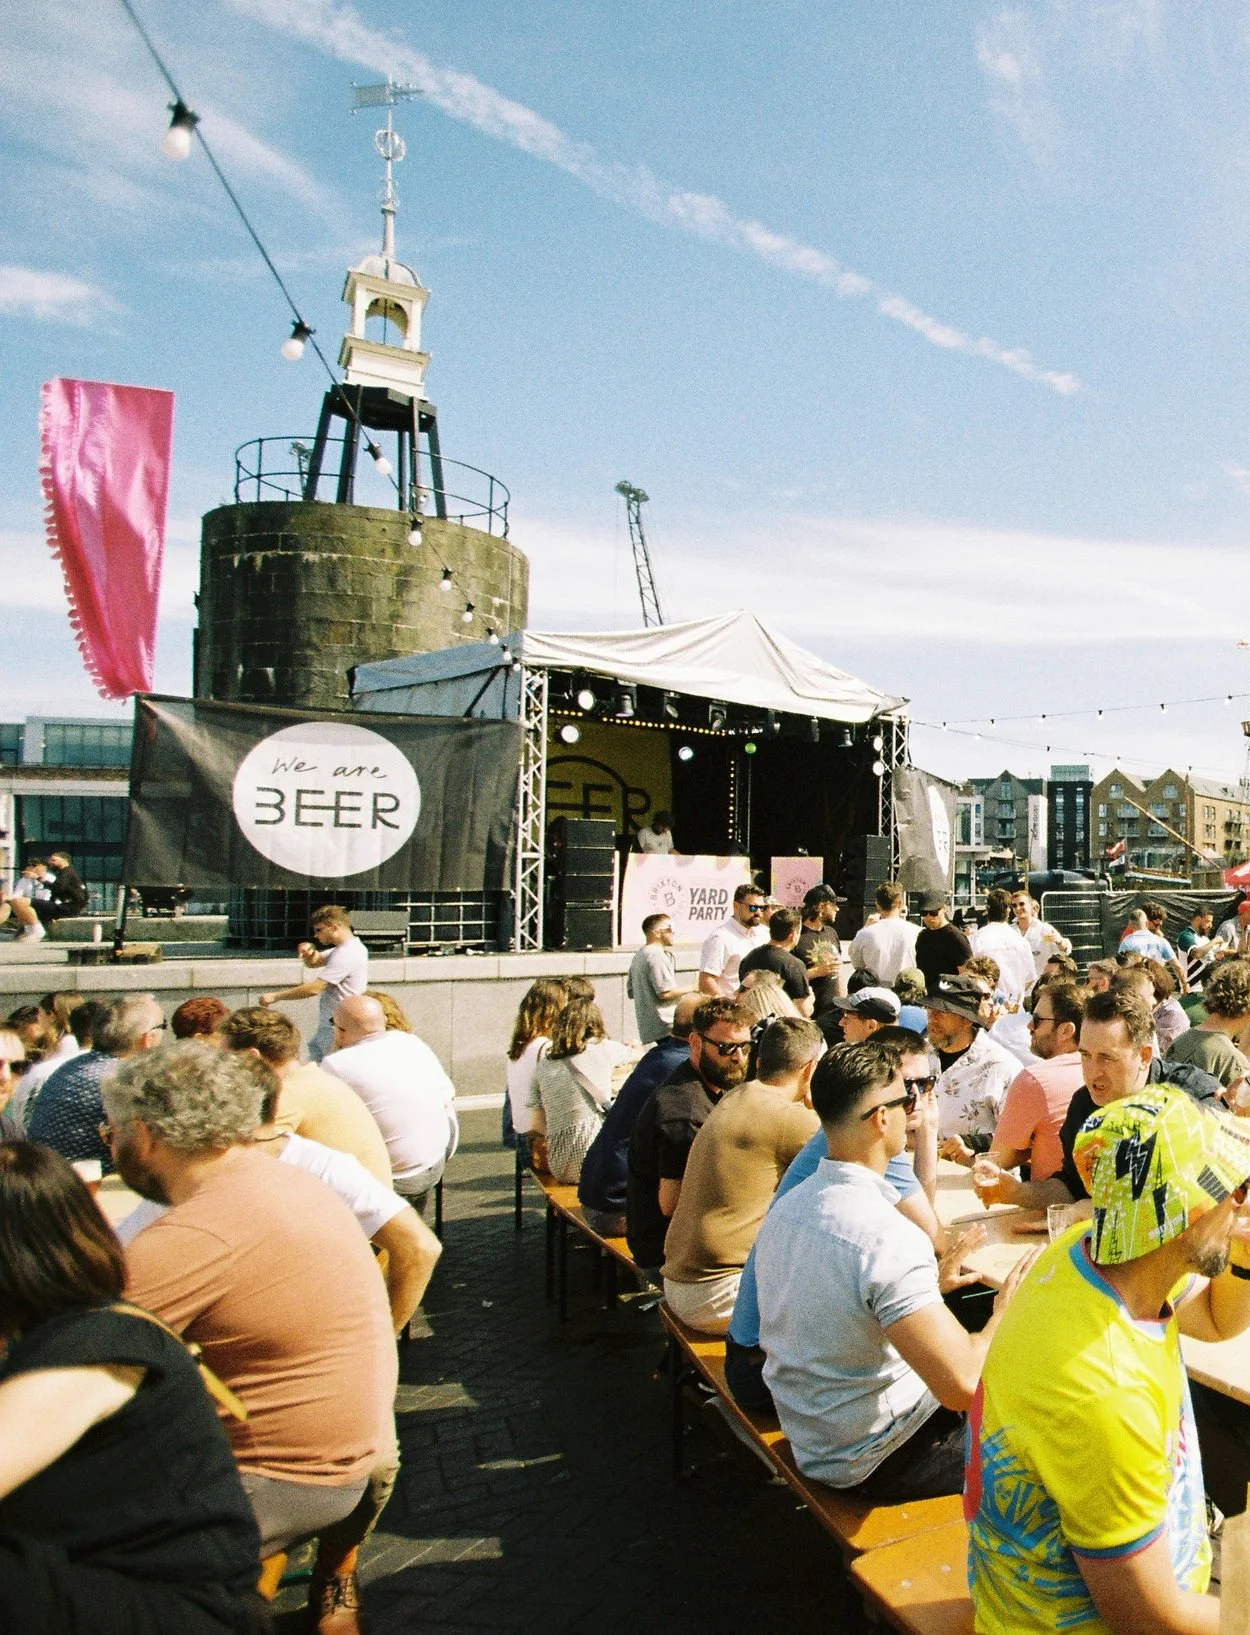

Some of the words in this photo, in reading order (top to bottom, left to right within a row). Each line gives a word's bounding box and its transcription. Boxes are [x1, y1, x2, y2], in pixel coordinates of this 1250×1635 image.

[271, 756, 318, 775] We
[332, 764, 388, 779] are
[254, 786, 401, 830] BEER
[650, 879, 682, 901] BRIXTON
[689, 888, 728, 905] YARD
[688, 906, 728, 920] PARTY
